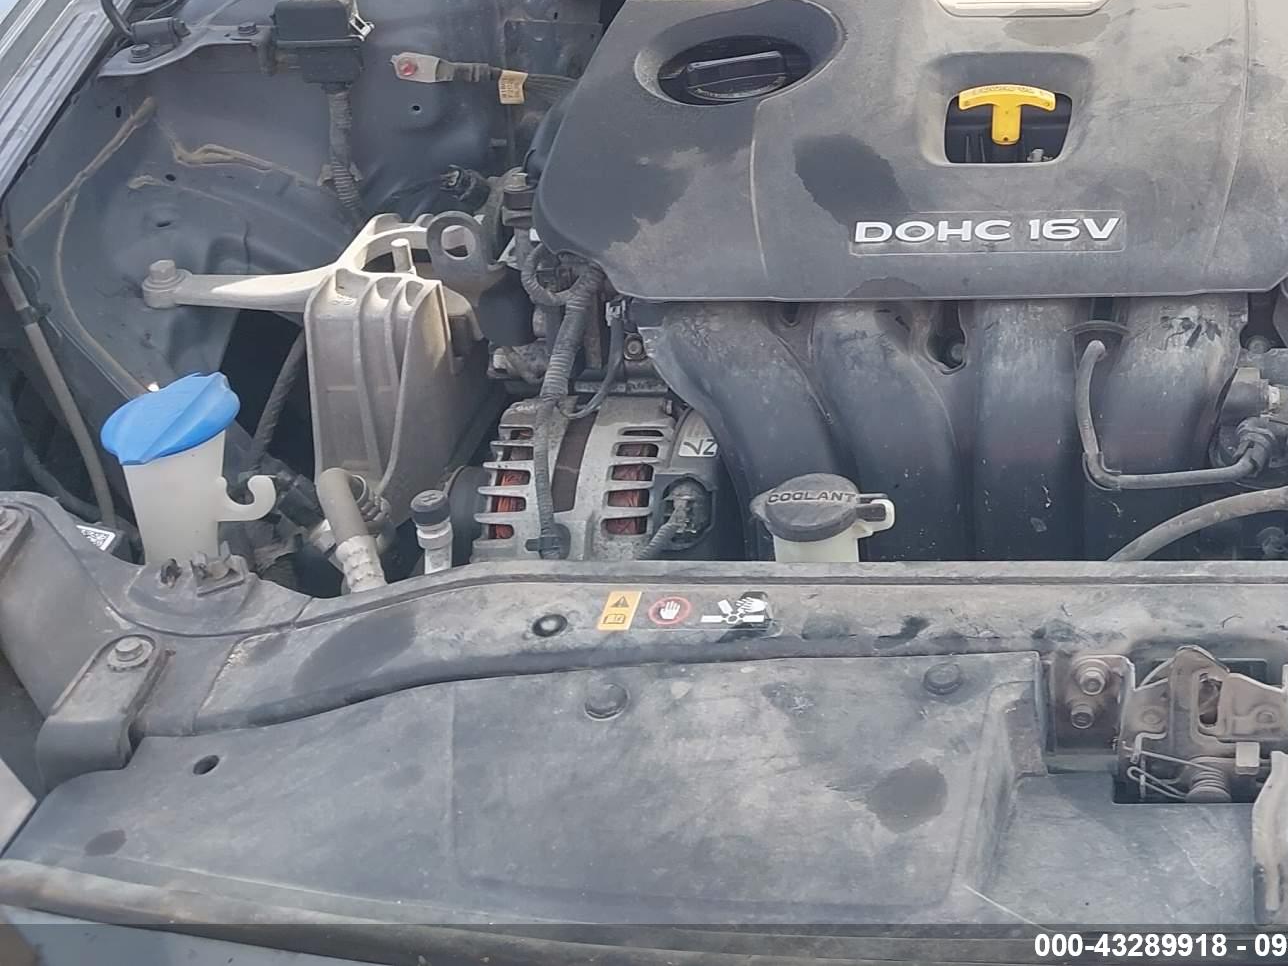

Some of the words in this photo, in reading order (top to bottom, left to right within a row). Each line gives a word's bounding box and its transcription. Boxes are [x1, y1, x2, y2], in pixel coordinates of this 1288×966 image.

[854, 220, 1012, 243] DOHC
[1029, 217, 1121, 241] 16V
[768, 492, 858, 504] COOLANT
